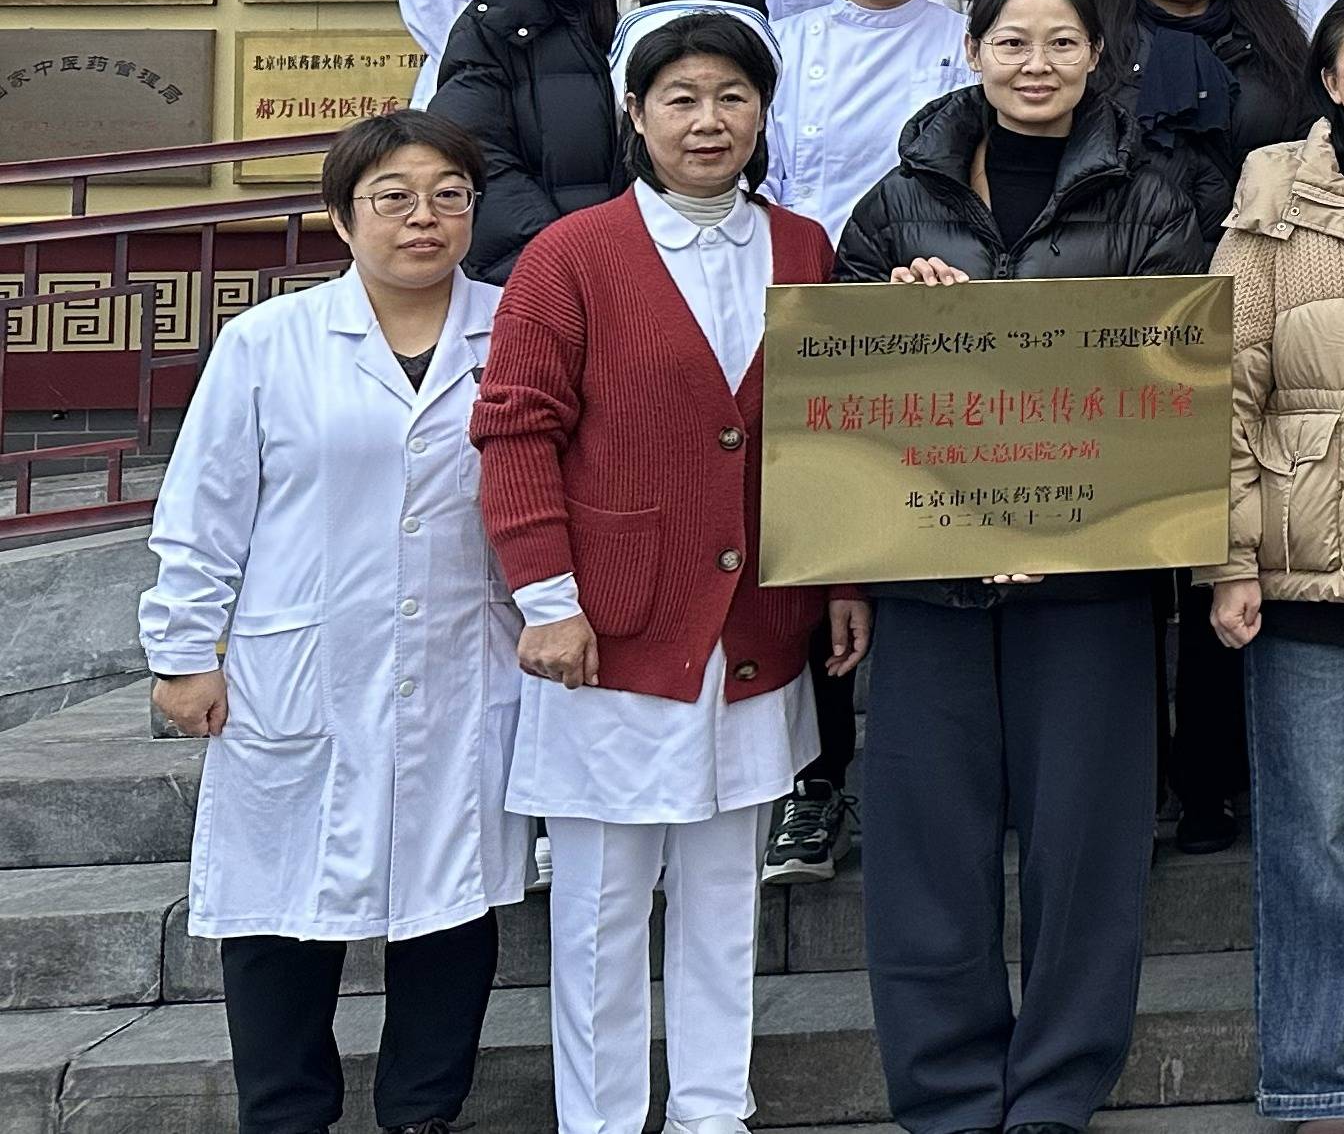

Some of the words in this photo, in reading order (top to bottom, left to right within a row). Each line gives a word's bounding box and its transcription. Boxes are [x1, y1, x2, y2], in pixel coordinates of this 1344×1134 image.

[806, 382, 1195, 433] 耿嘉玮基层老中医传承工作室
[901, 439, 1100, 466] 北京航天总医院分站
[905, 483, 1094, 508] 北京市中医药管理局
